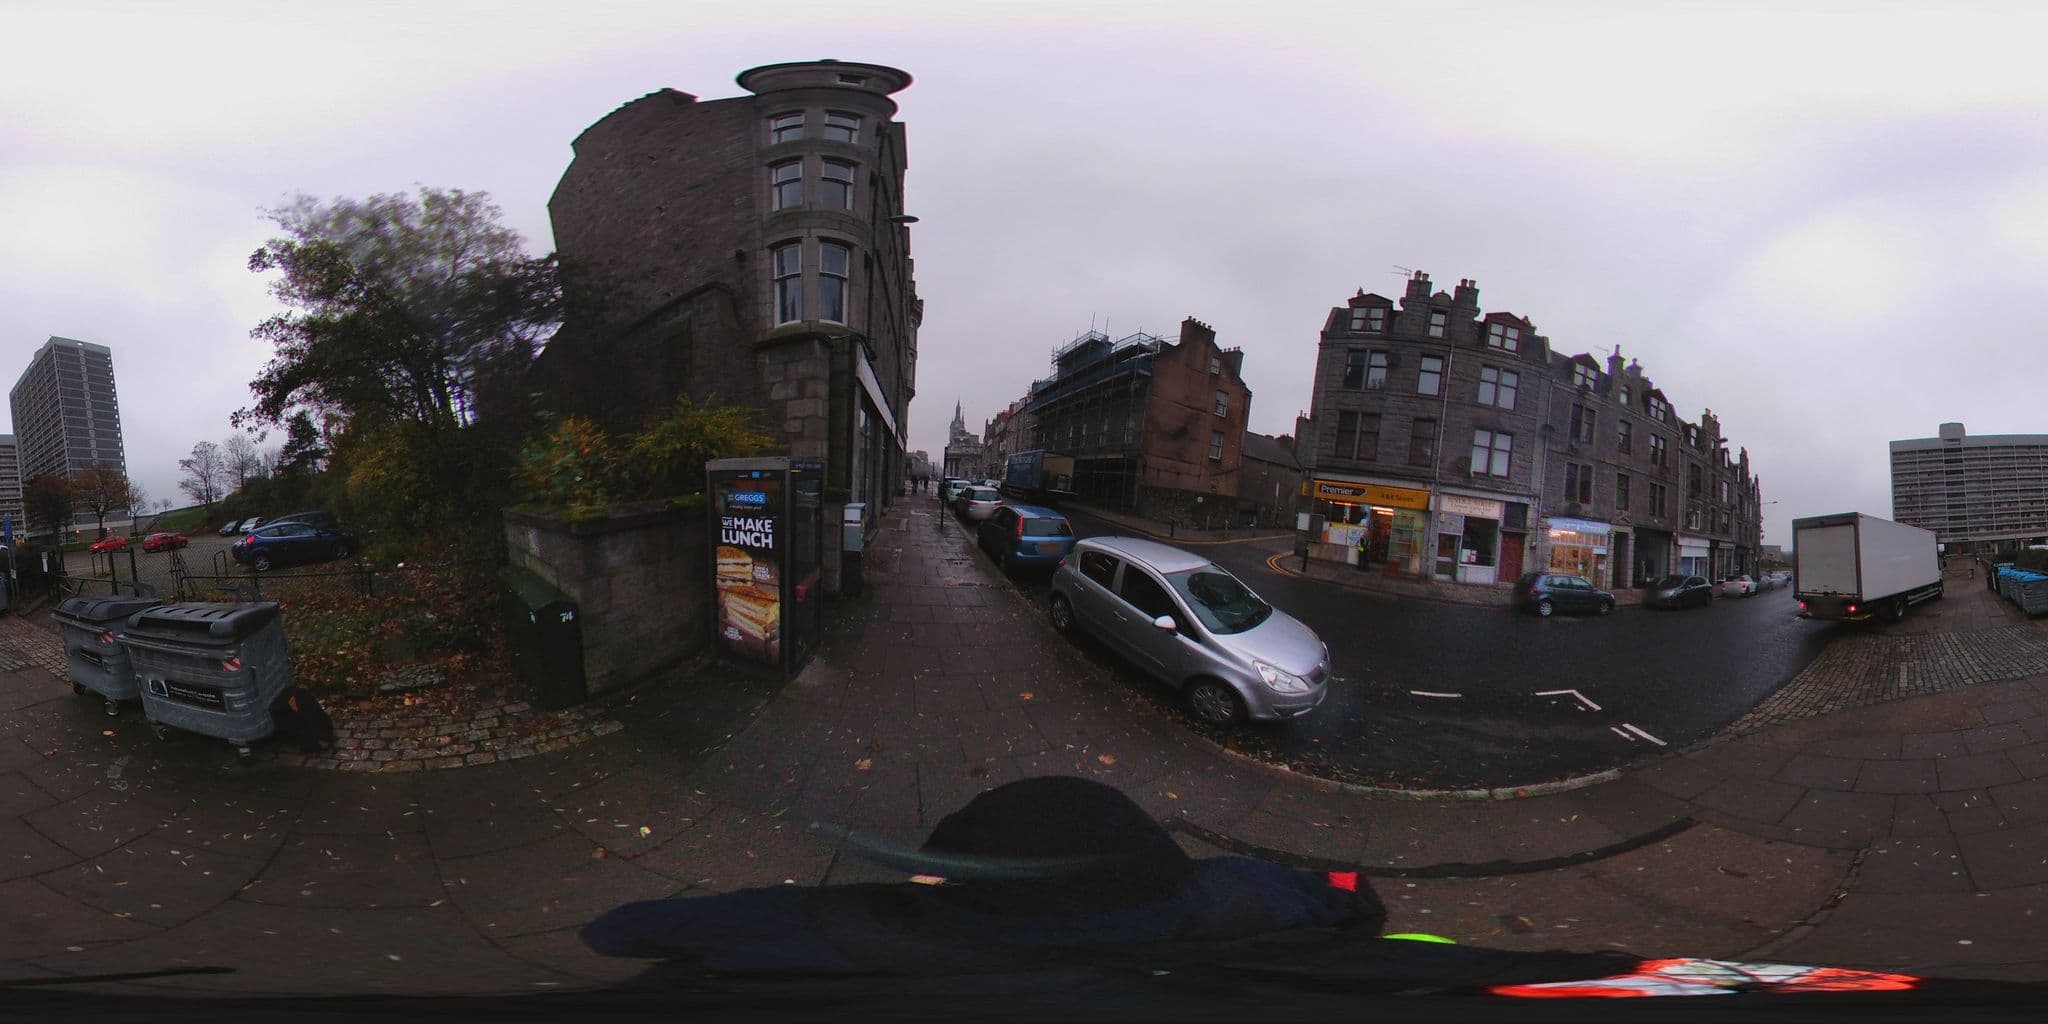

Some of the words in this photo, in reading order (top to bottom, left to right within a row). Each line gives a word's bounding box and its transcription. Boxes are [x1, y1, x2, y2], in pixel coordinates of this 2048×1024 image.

[1321, 485, 1354, 495] Premier
[735, 494, 764, 502] GREGGS
[722, 518, 733, 527] WE
[734, 517, 773, 533] MAKE
[721, 529, 773, 549] LUNCH
[560, 611, 573, 622] 74
